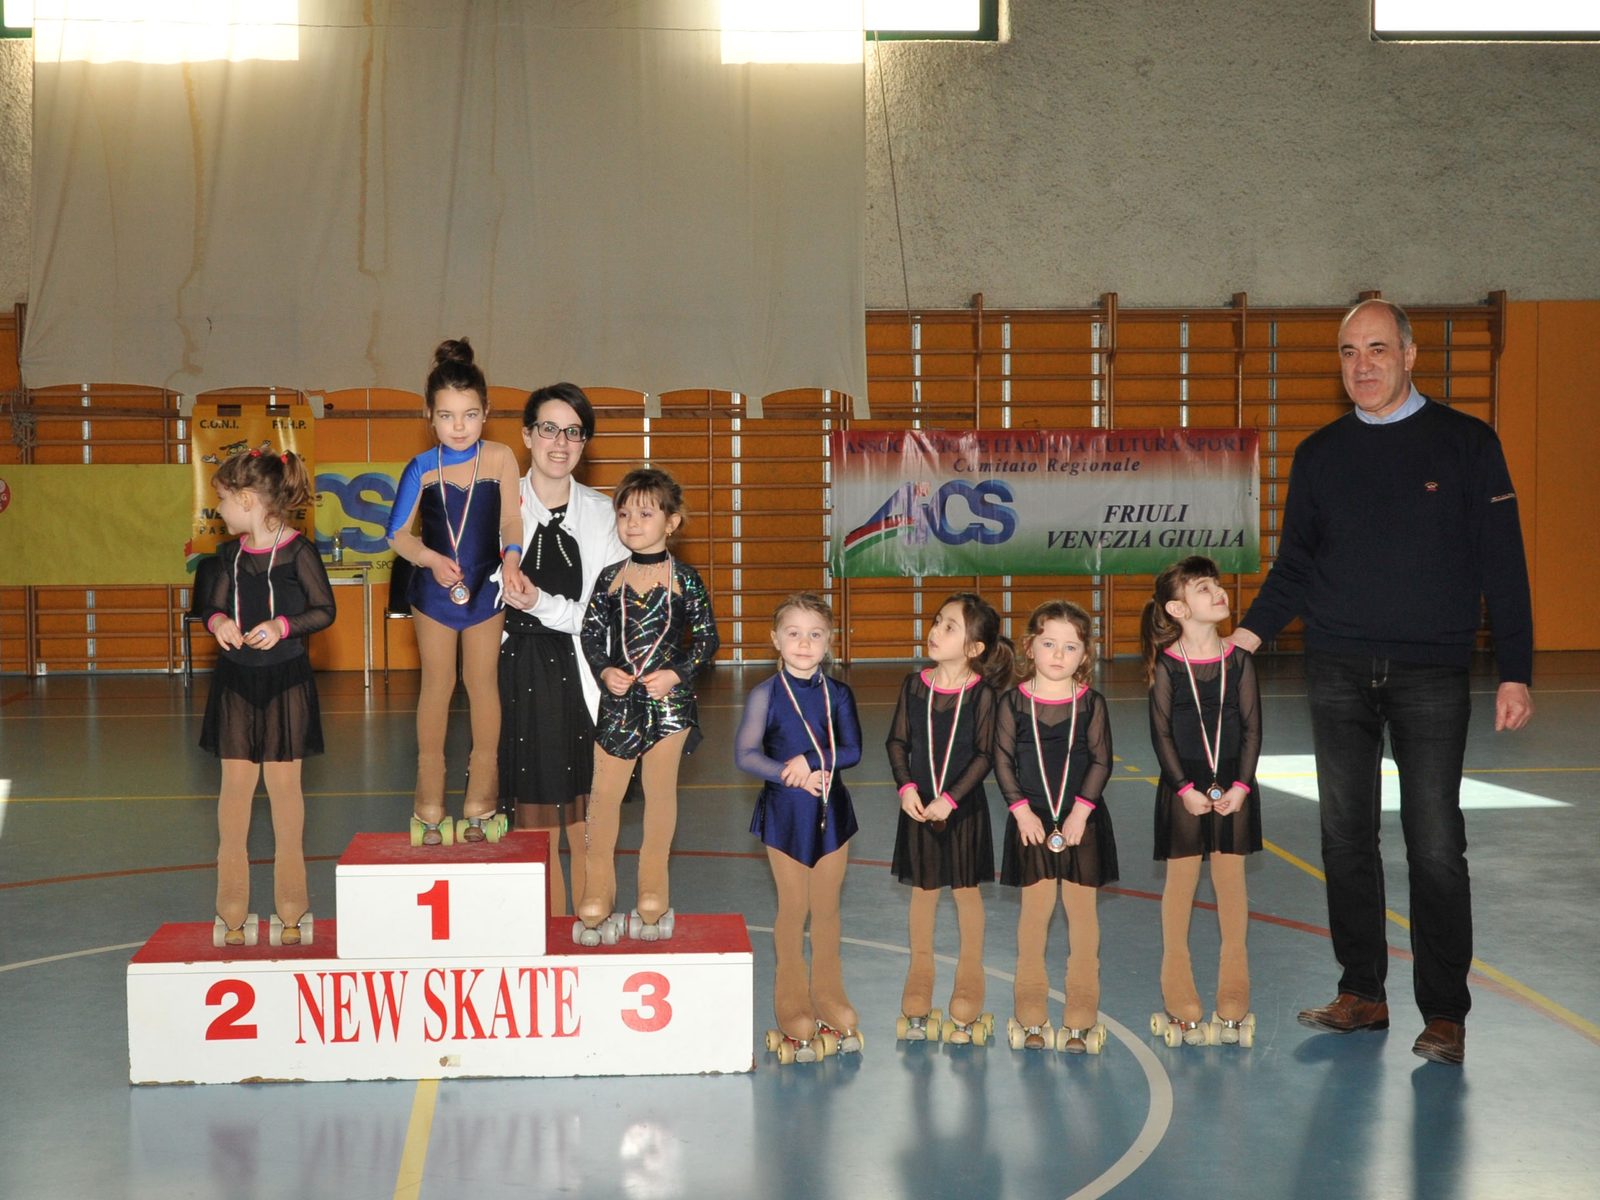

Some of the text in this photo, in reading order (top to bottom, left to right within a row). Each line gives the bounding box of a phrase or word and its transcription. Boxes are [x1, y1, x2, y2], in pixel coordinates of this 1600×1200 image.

[199, 419, 239, 429] C.O.N.I.
[272, 419, 307, 430] F.I.H.P.
[1186, 435, 1249, 453] SPORT
[953, 456, 1141, 475] Comitato Regionale
[201, 508, 223, 520] NE
[1103, 503, 1189, 524] FRIULI
[199, 526, 227, 535] PAS
[1047, 528, 1245, 549] VENEZIA GIULIA
[376, 560, 393, 570] SPO
[416, 879, 450, 941] 1
[204, 978, 258, 1041] 2
[293, 966, 582, 1045] NEW SKATE
[620, 970, 673, 1033] 3
